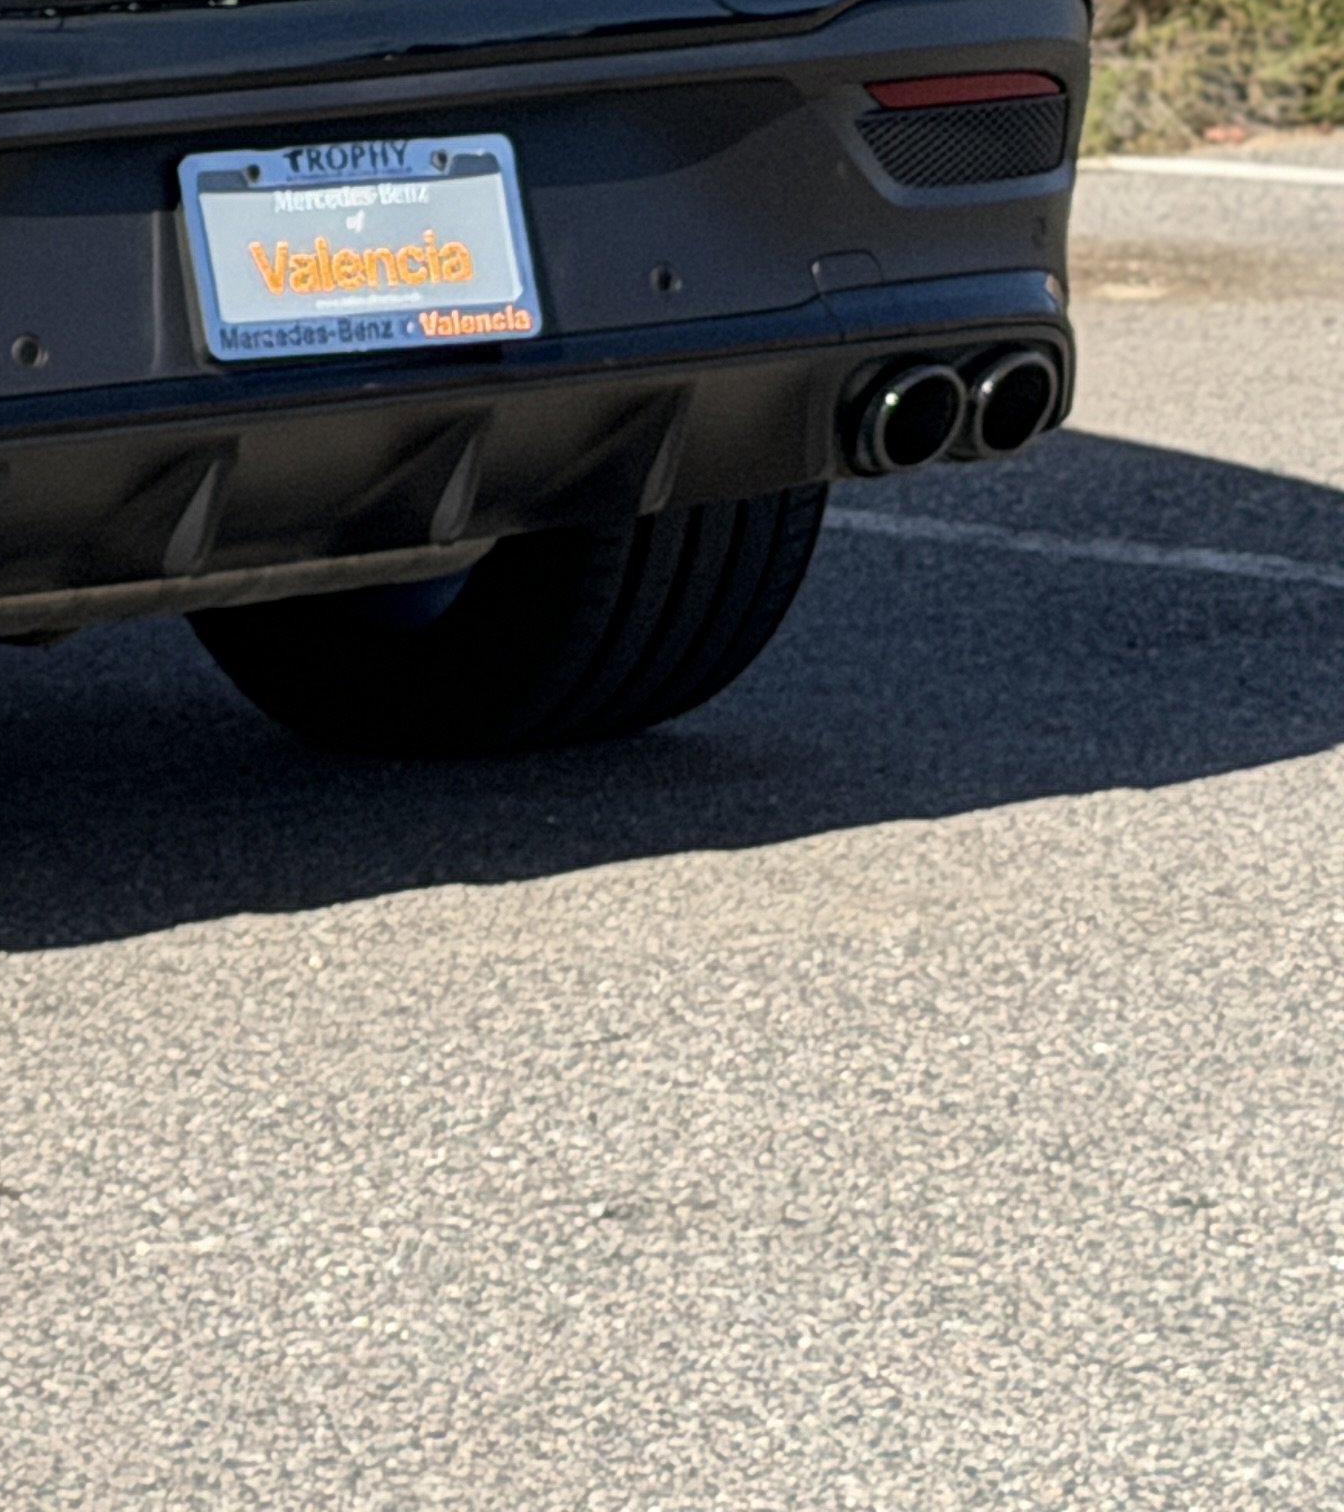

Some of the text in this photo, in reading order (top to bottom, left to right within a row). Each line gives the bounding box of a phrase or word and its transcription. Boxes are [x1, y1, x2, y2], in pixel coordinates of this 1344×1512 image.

[282, 139, 409, 173] TROPHY
[272, 182, 430, 213] Mercedes-Benz
[345, 209, 366, 233] of
[248, 229, 474, 296] Valencia
[219, 316, 394, 351] Mercedes-Benz
[418, 304, 533, 338] Valencia
